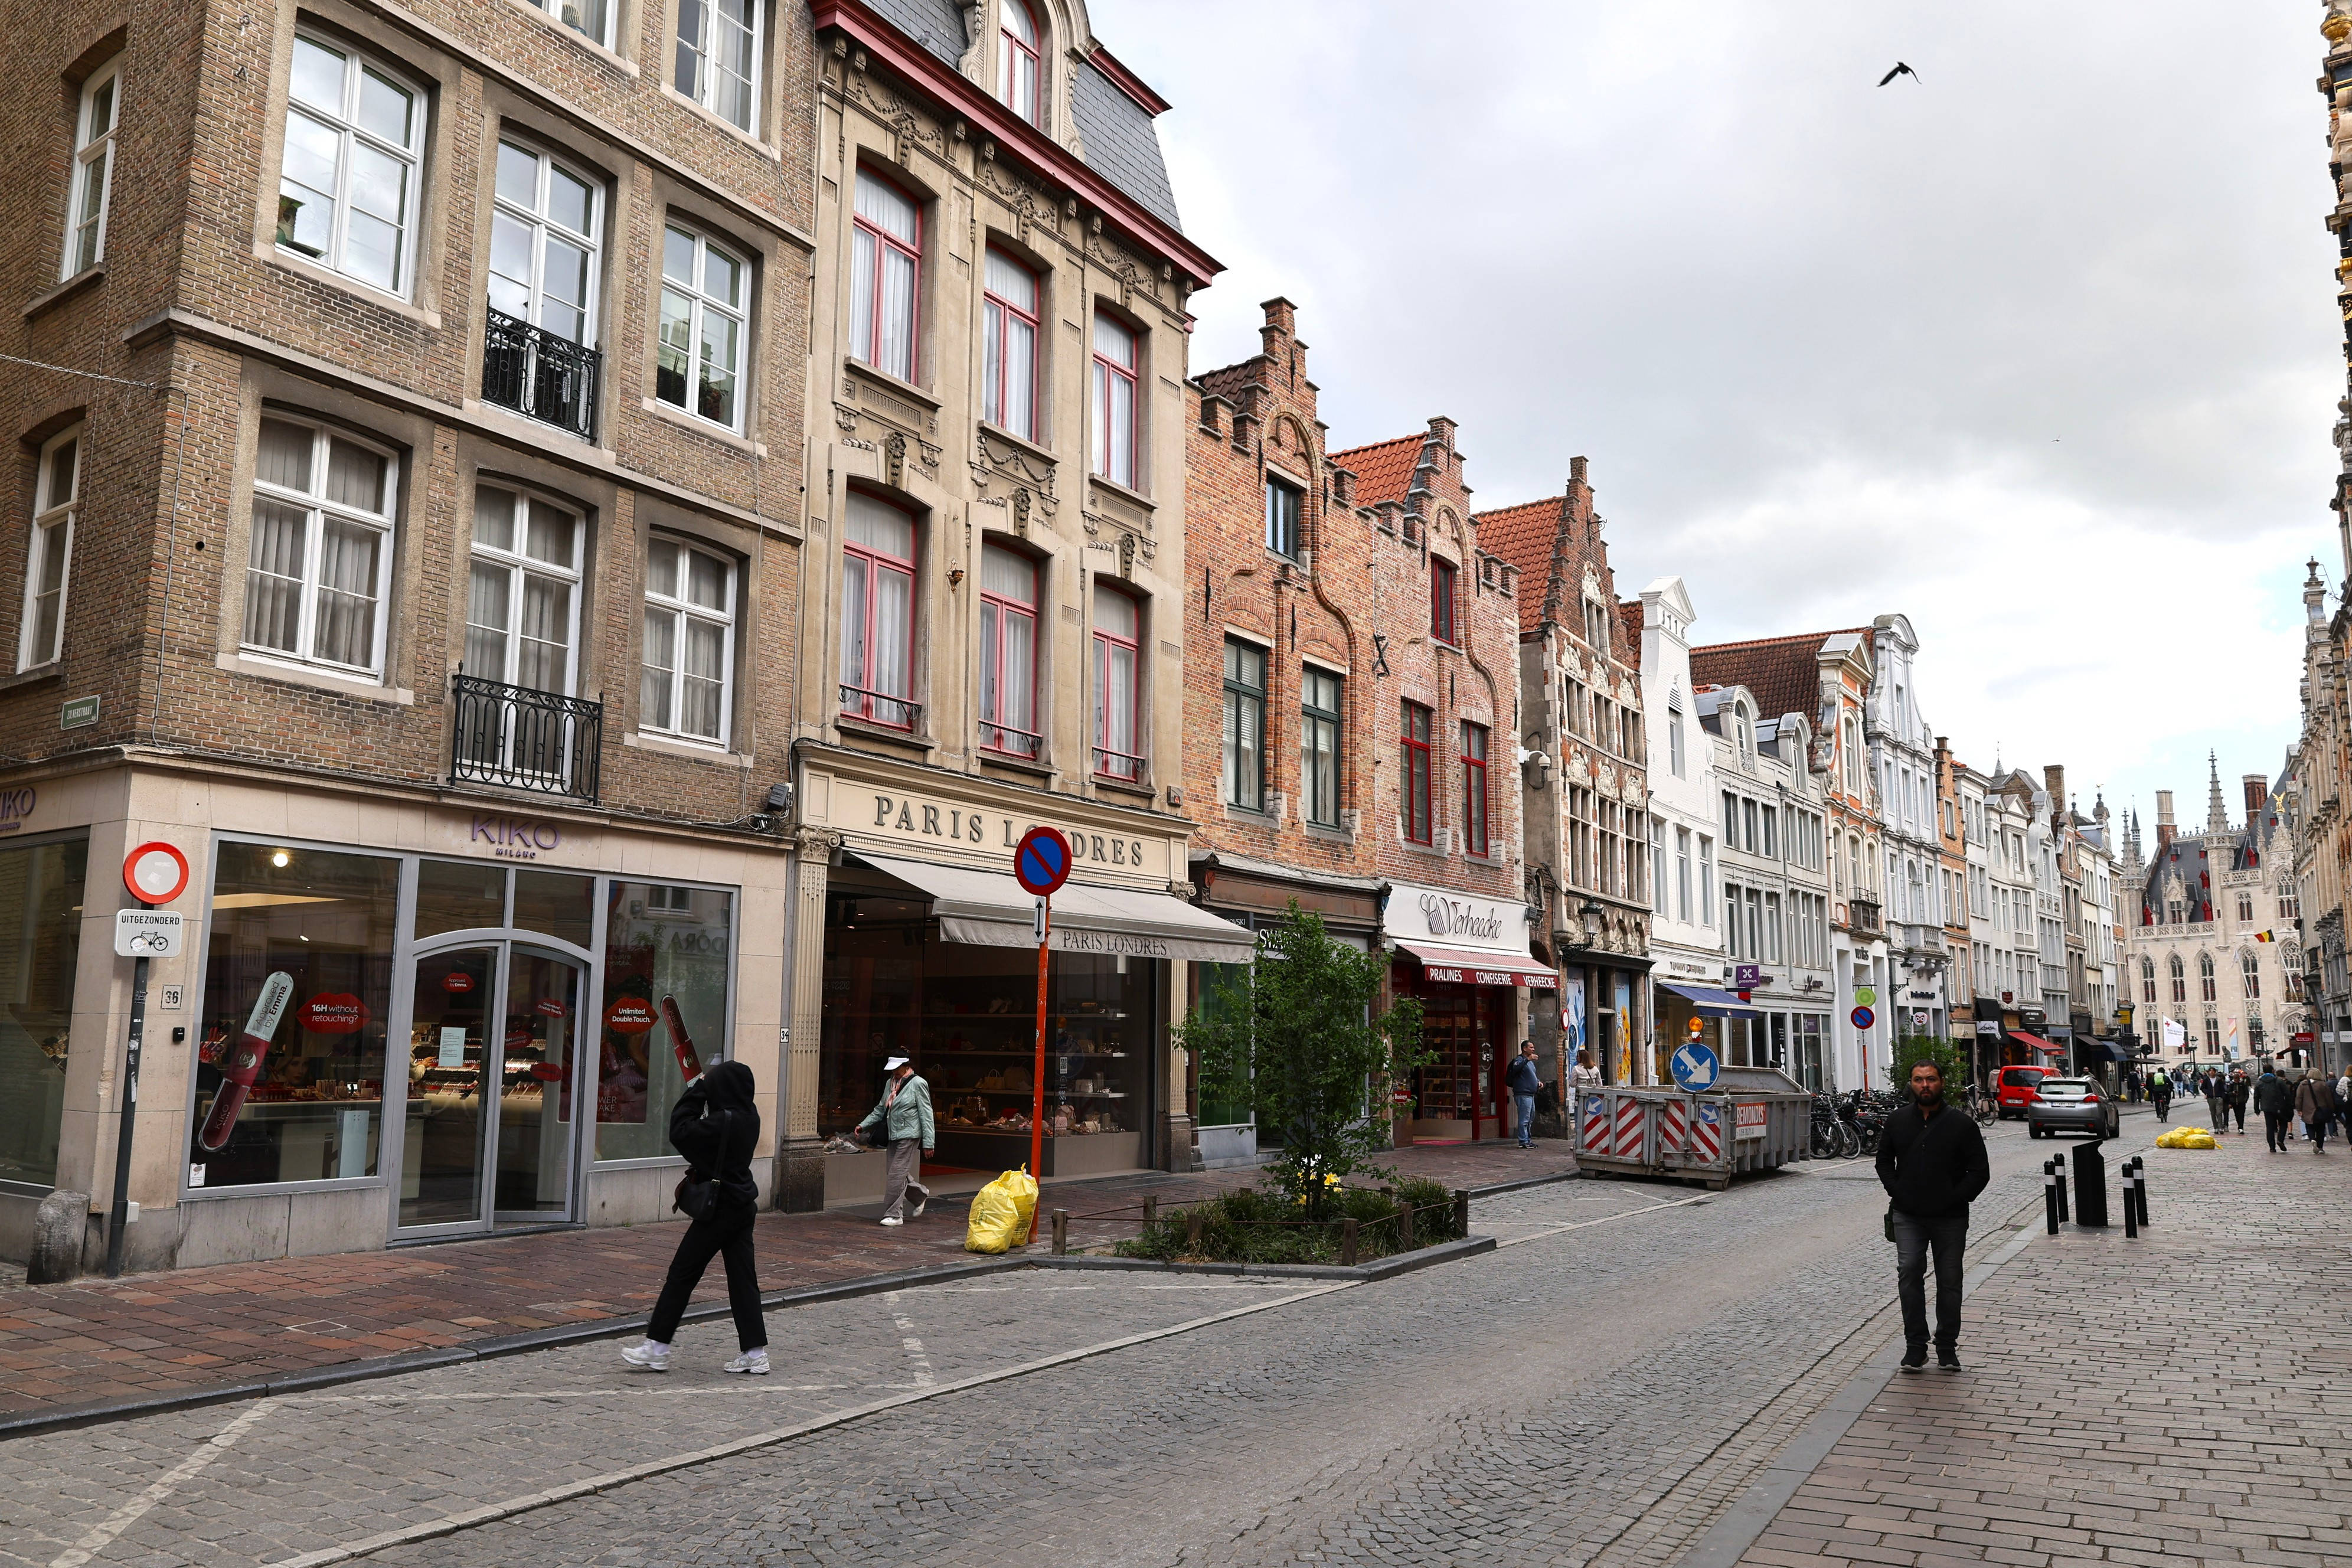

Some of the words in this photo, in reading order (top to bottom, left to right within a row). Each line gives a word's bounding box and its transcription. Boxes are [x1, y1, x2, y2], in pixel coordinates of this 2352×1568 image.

[0, 787, 35, 819] IKO
[472, 815, 560, 849] KIKO
[875, 795, 983, 842] PARIS
[1003, 819, 1142, 866] LDRES
[496, 848, 536, 858] MILANO
[122, 915, 179, 925] UITGEZONDERD
[1440, 897, 1502, 939] Verheecke
[1063, 931, 1102, 950] PARIS
[1107, 935, 1167, 956] LONDRES
[1430, 968, 1462, 982] PRALINES
[1476, 972, 1513, 985] CONFISERIE
[1523, 975, 1556, 988] VERHEECKE
[165, 991, 179, 1004] 36
[255, 981, 279, 1025] Approved
[263, 1016, 275, 1028] by
[269, 985, 288, 1015] Emma.
[329, 1004, 358, 1013] without
[312, 1014, 358, 1024] retouching?
[781, 1030, 789, 1040] 34
[215, 1105, 229, 1129] KIKO
[1737, 1105, 1764, 1125] REMONDIS
